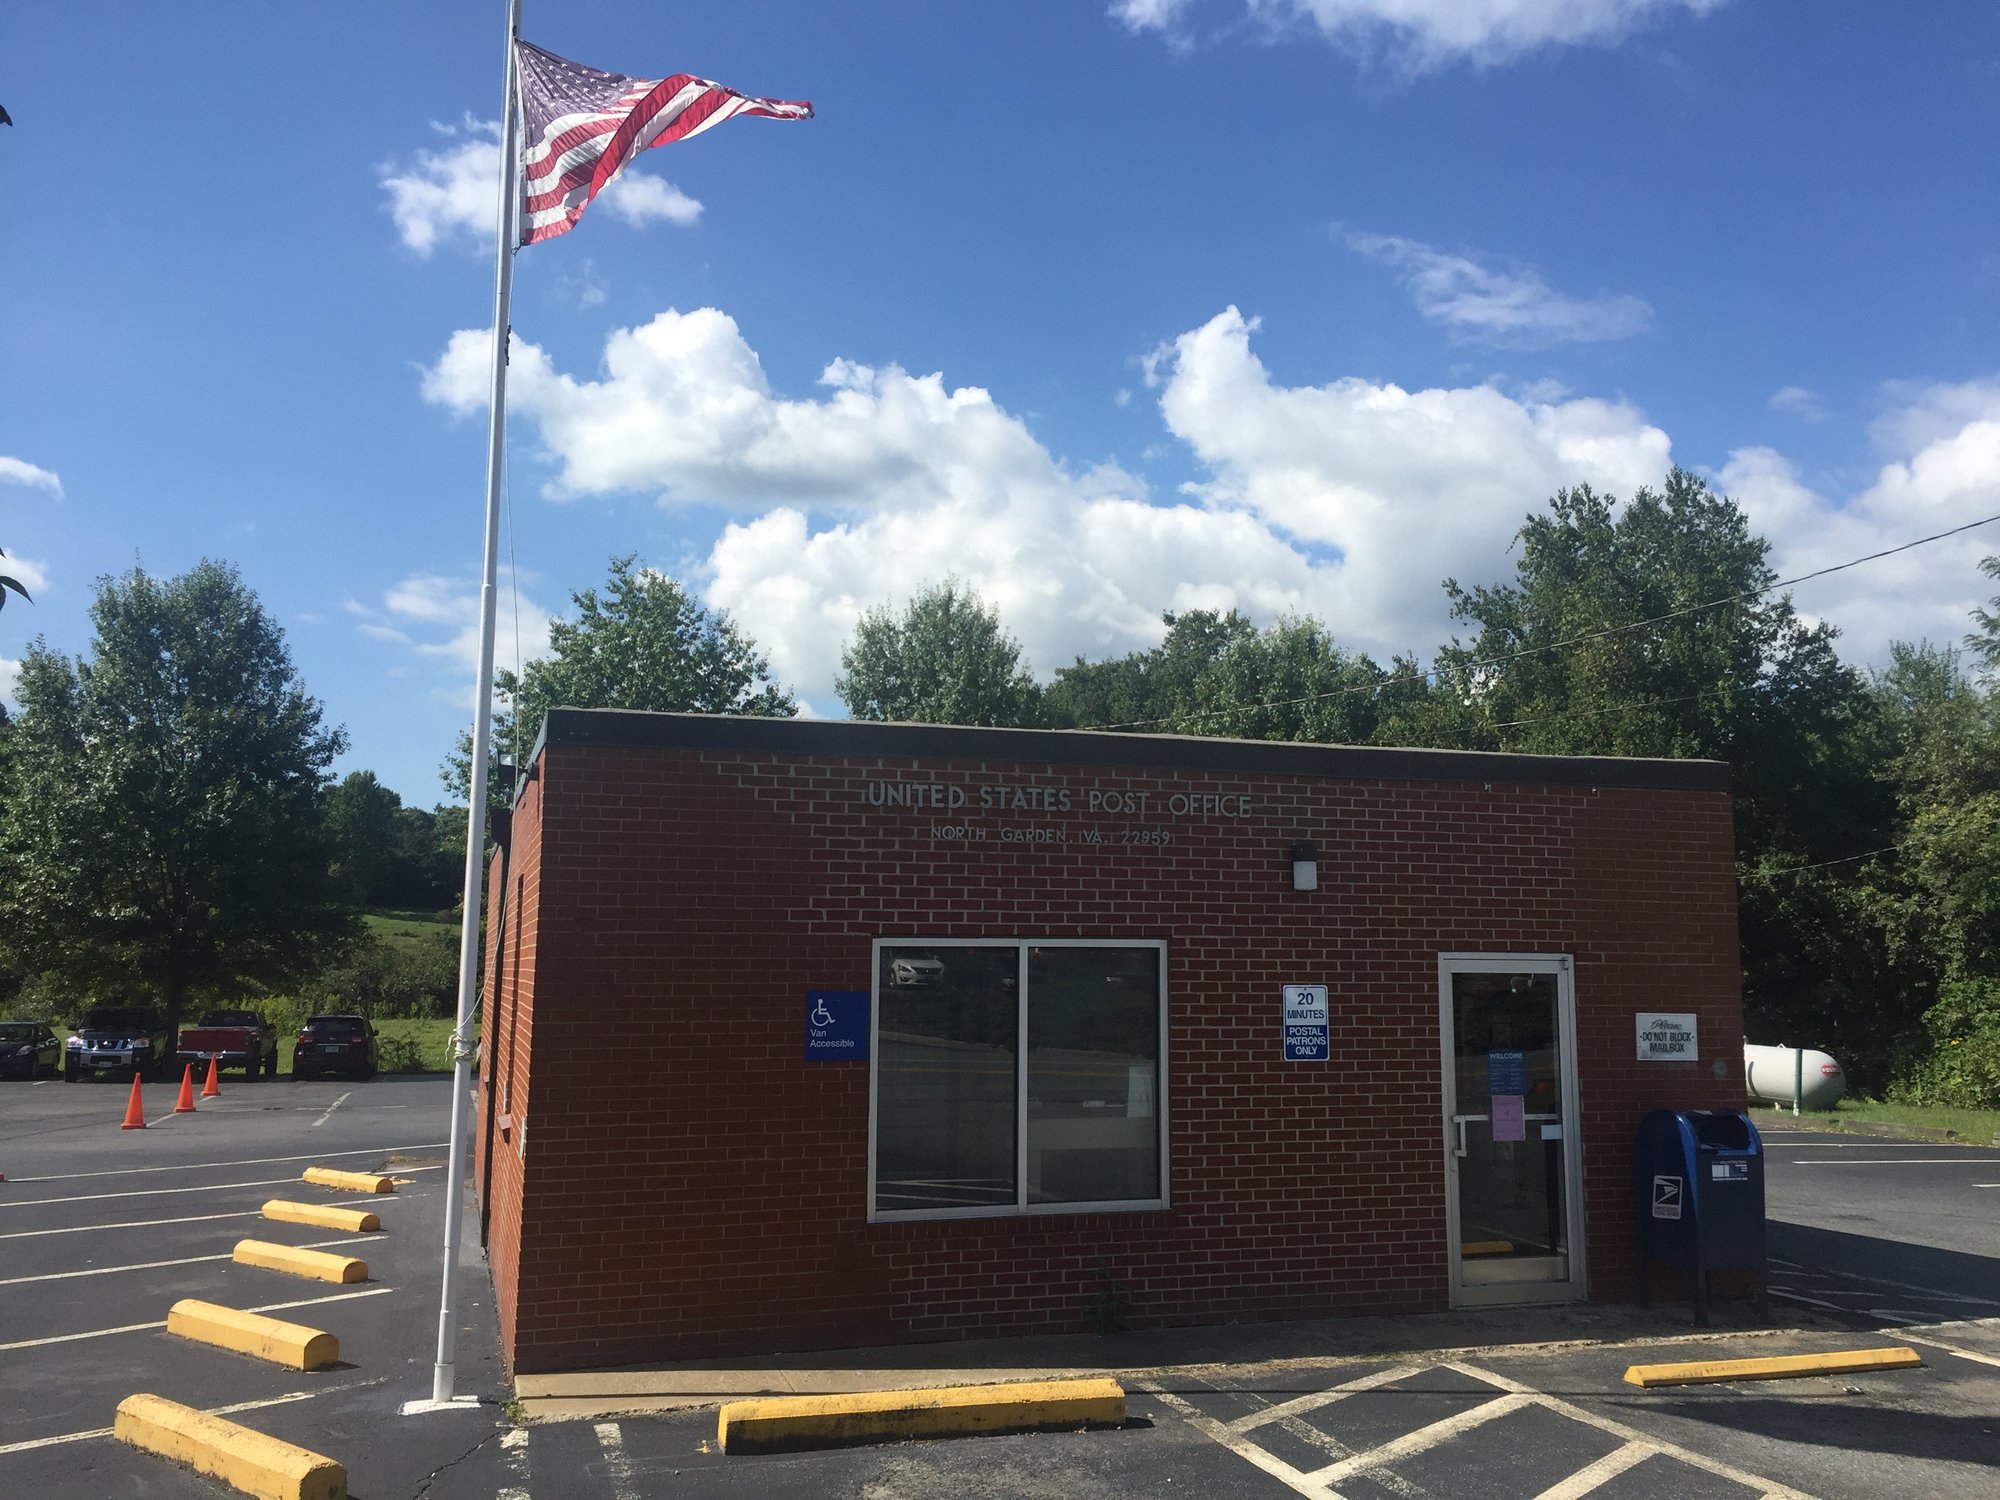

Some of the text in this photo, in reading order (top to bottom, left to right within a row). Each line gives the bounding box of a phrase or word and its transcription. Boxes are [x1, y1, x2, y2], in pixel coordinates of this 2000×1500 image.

[868, 782, 1252, 818] UNITED STATES POST OFFICE
[931, 825, 987, 841] NORTH
[1121, 830, 1170, 846] 22959
[1297, 992, 1314, 1006] 20
[1287, 1009, 1325, 1019] MINUTES
[810, 1029, 827, 1037] Van
[1289, 1026, 1323, 1036] POSTAL
[1286, 1036, 1327, 1046] PATRONS
[1642, 1031, 1692, 1042] DO NOT BLOCK
[809, 1039, 855, 1048] Accessible
[1649, 1042, 1685, 1053] MAILBOX
[1295, 1046, 1318, 1055] ONLY
[1489, 1052, 1523, 1060] WELCOME
